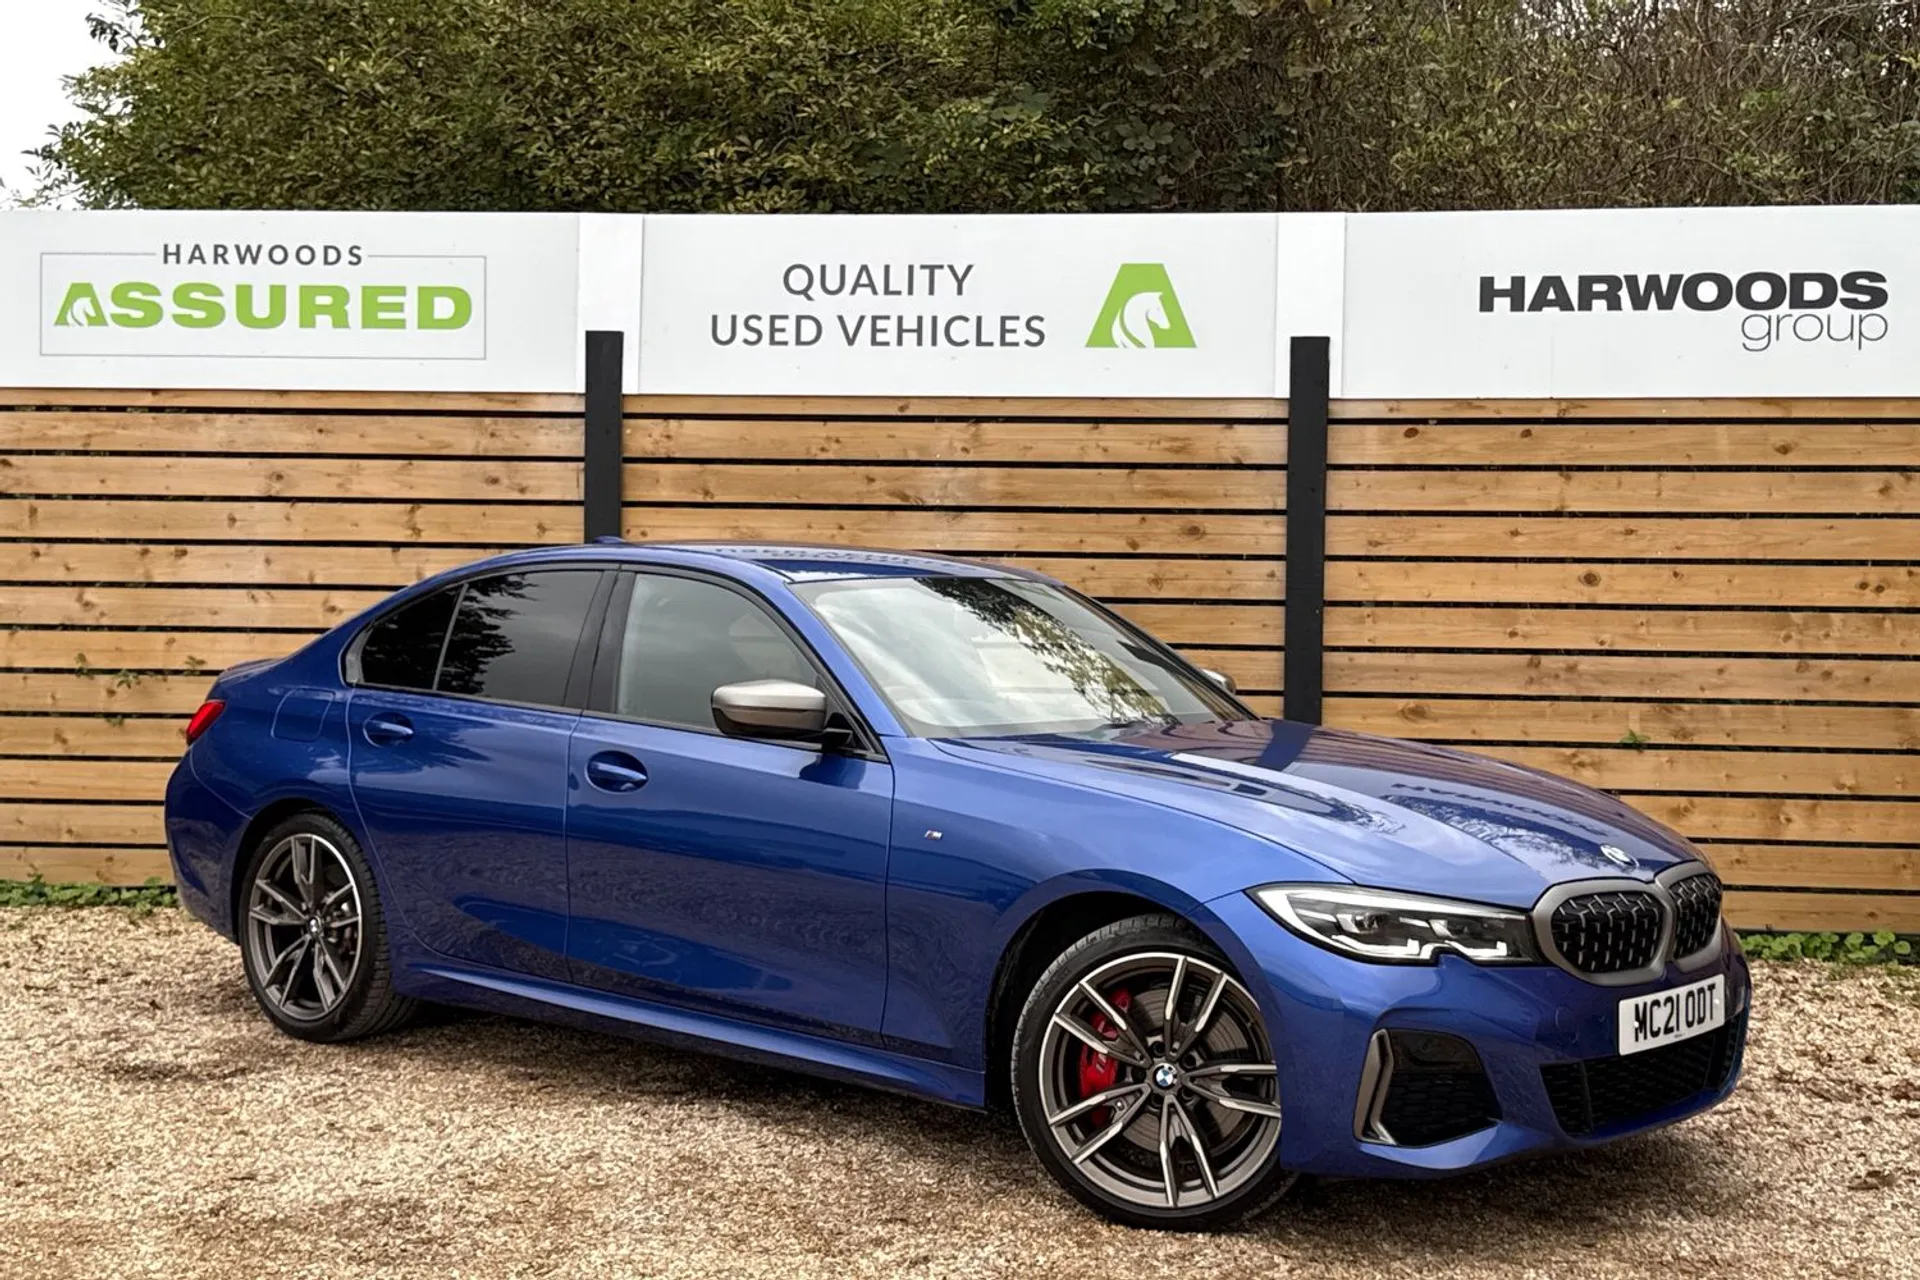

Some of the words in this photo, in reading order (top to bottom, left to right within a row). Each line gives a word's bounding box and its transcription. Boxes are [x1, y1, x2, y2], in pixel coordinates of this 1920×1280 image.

[163, 243, 362, 266] HARWOODS
[783, 263, 974, 301] QUALITY
[1479, 270, 1889, 312] HARWOODS
[54, 281, 472, 330] ASSURED
[711, 314, 823, 346] USED
[837, 314, 1045, 347] VEHICLES
[1741, 313, 1889, 352] group
